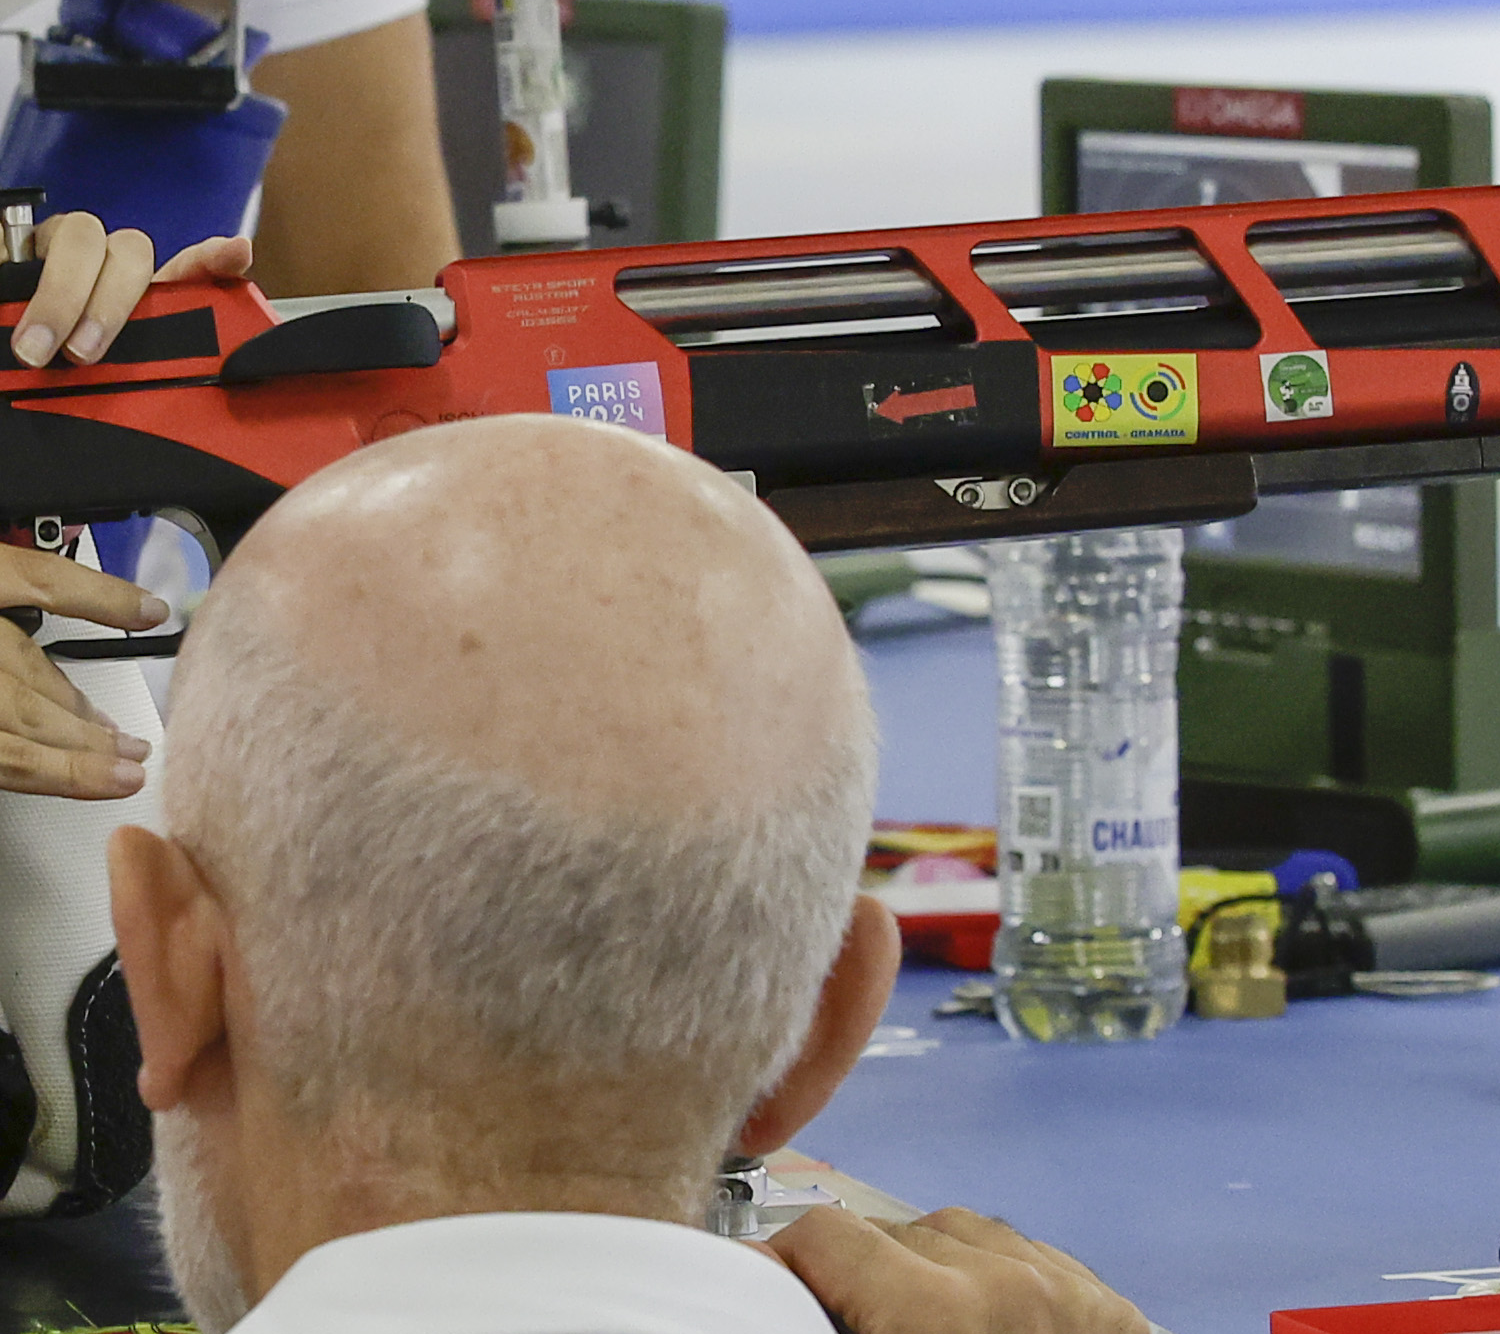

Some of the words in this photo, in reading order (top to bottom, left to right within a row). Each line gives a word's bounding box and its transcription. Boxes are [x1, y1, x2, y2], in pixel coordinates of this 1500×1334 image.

[567, 379, 642, 404] PARIS
[1065, 430, 1120, 440] CONTROL
[1130, 428, 1186, 439] GRANADA
